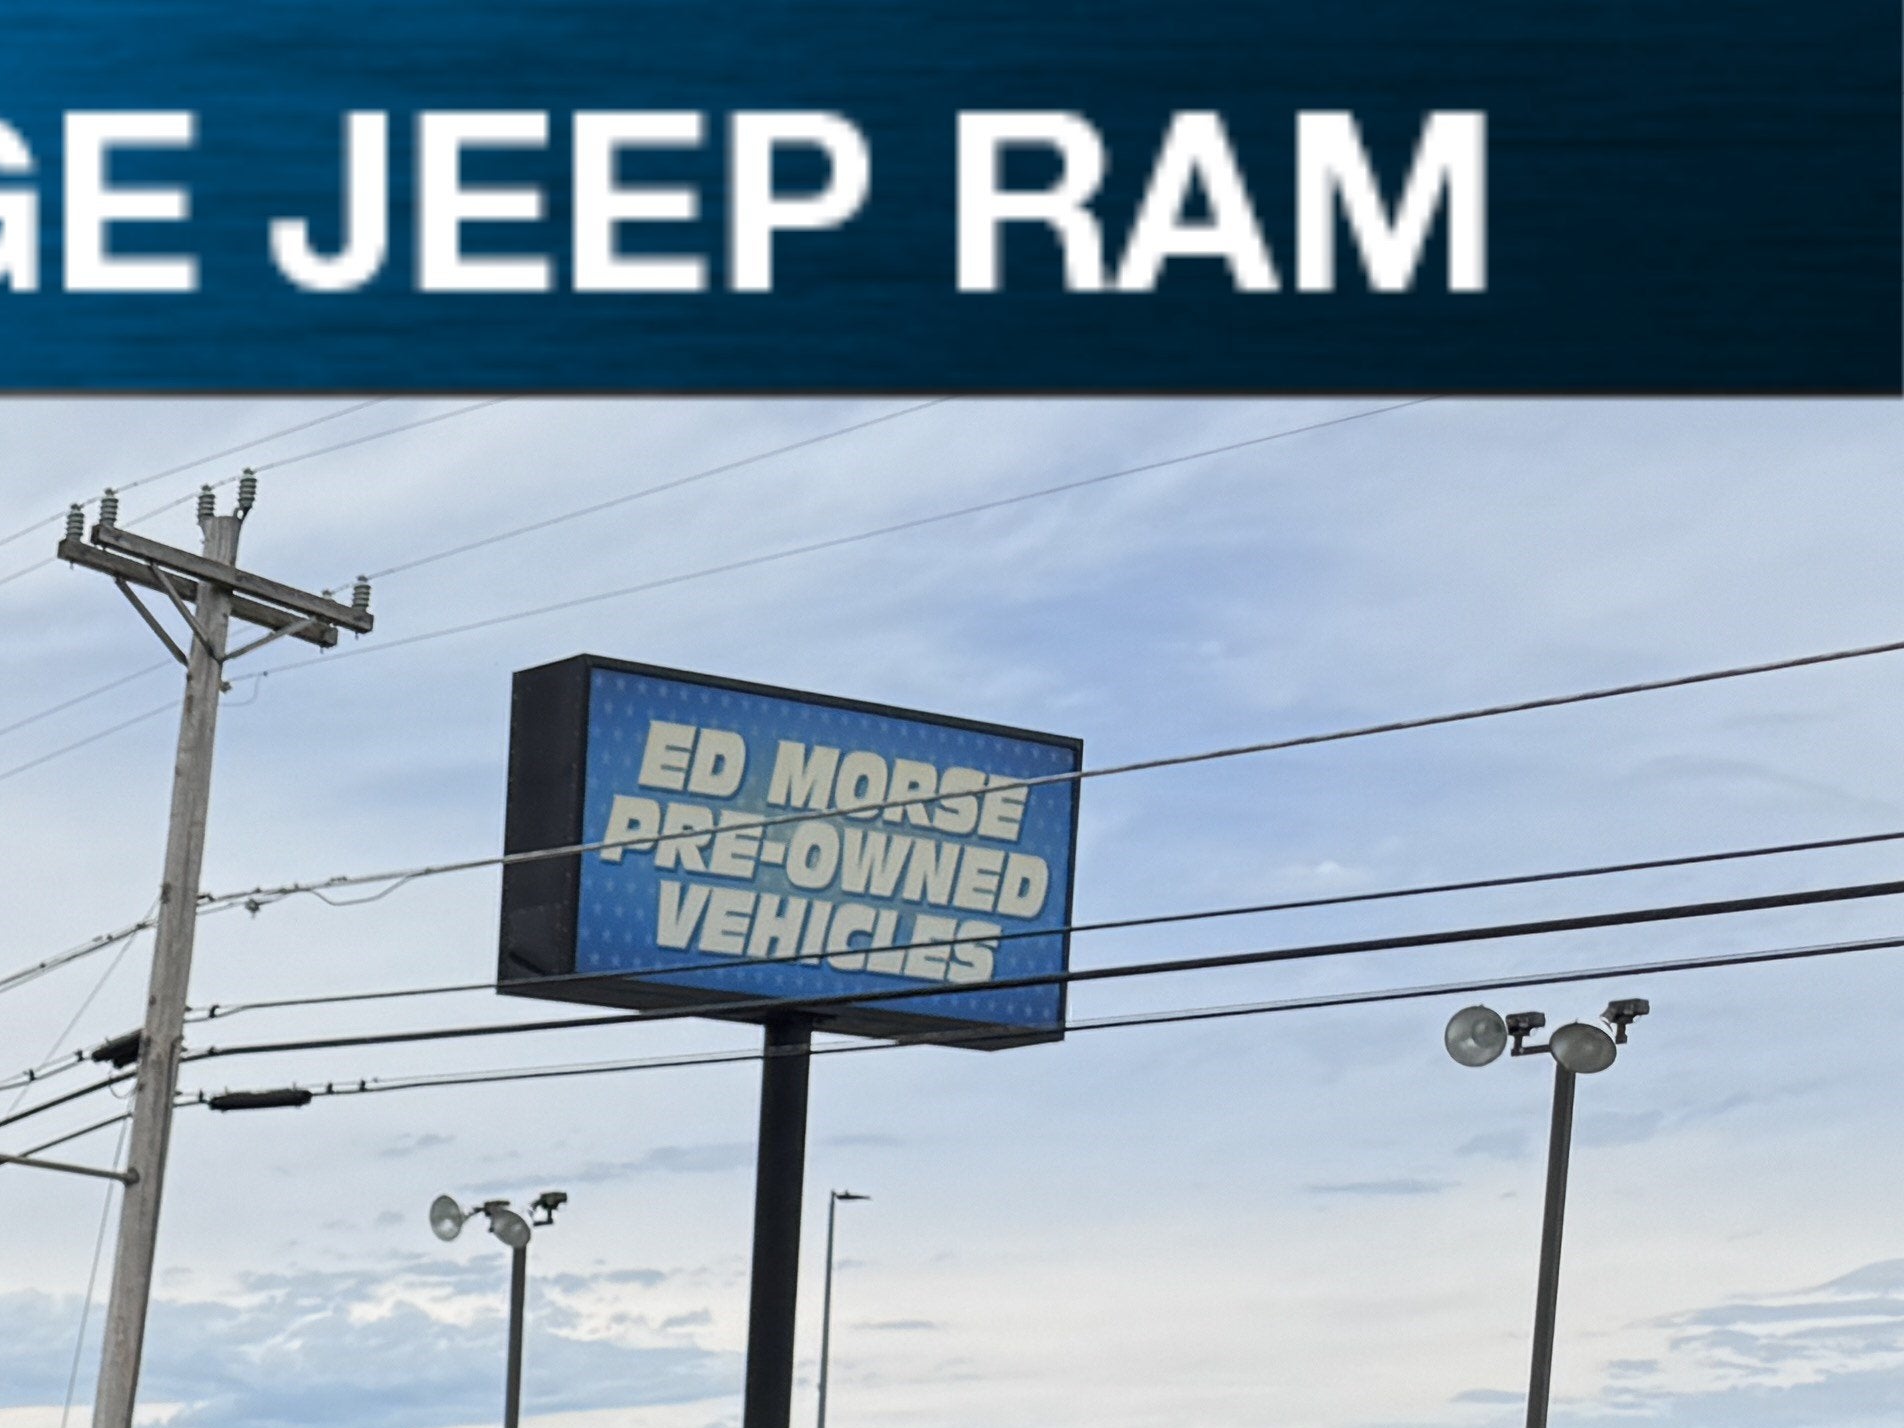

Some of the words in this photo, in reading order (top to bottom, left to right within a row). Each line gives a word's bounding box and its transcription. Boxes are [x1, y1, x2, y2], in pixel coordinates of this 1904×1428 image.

[638, 719, 747, 798] ED
[766, 739, 1032, 841] MORSE
[599, 793, 1051, 919] PRE-OWNED
[655, 879, 1003, 984] VEHICLES
